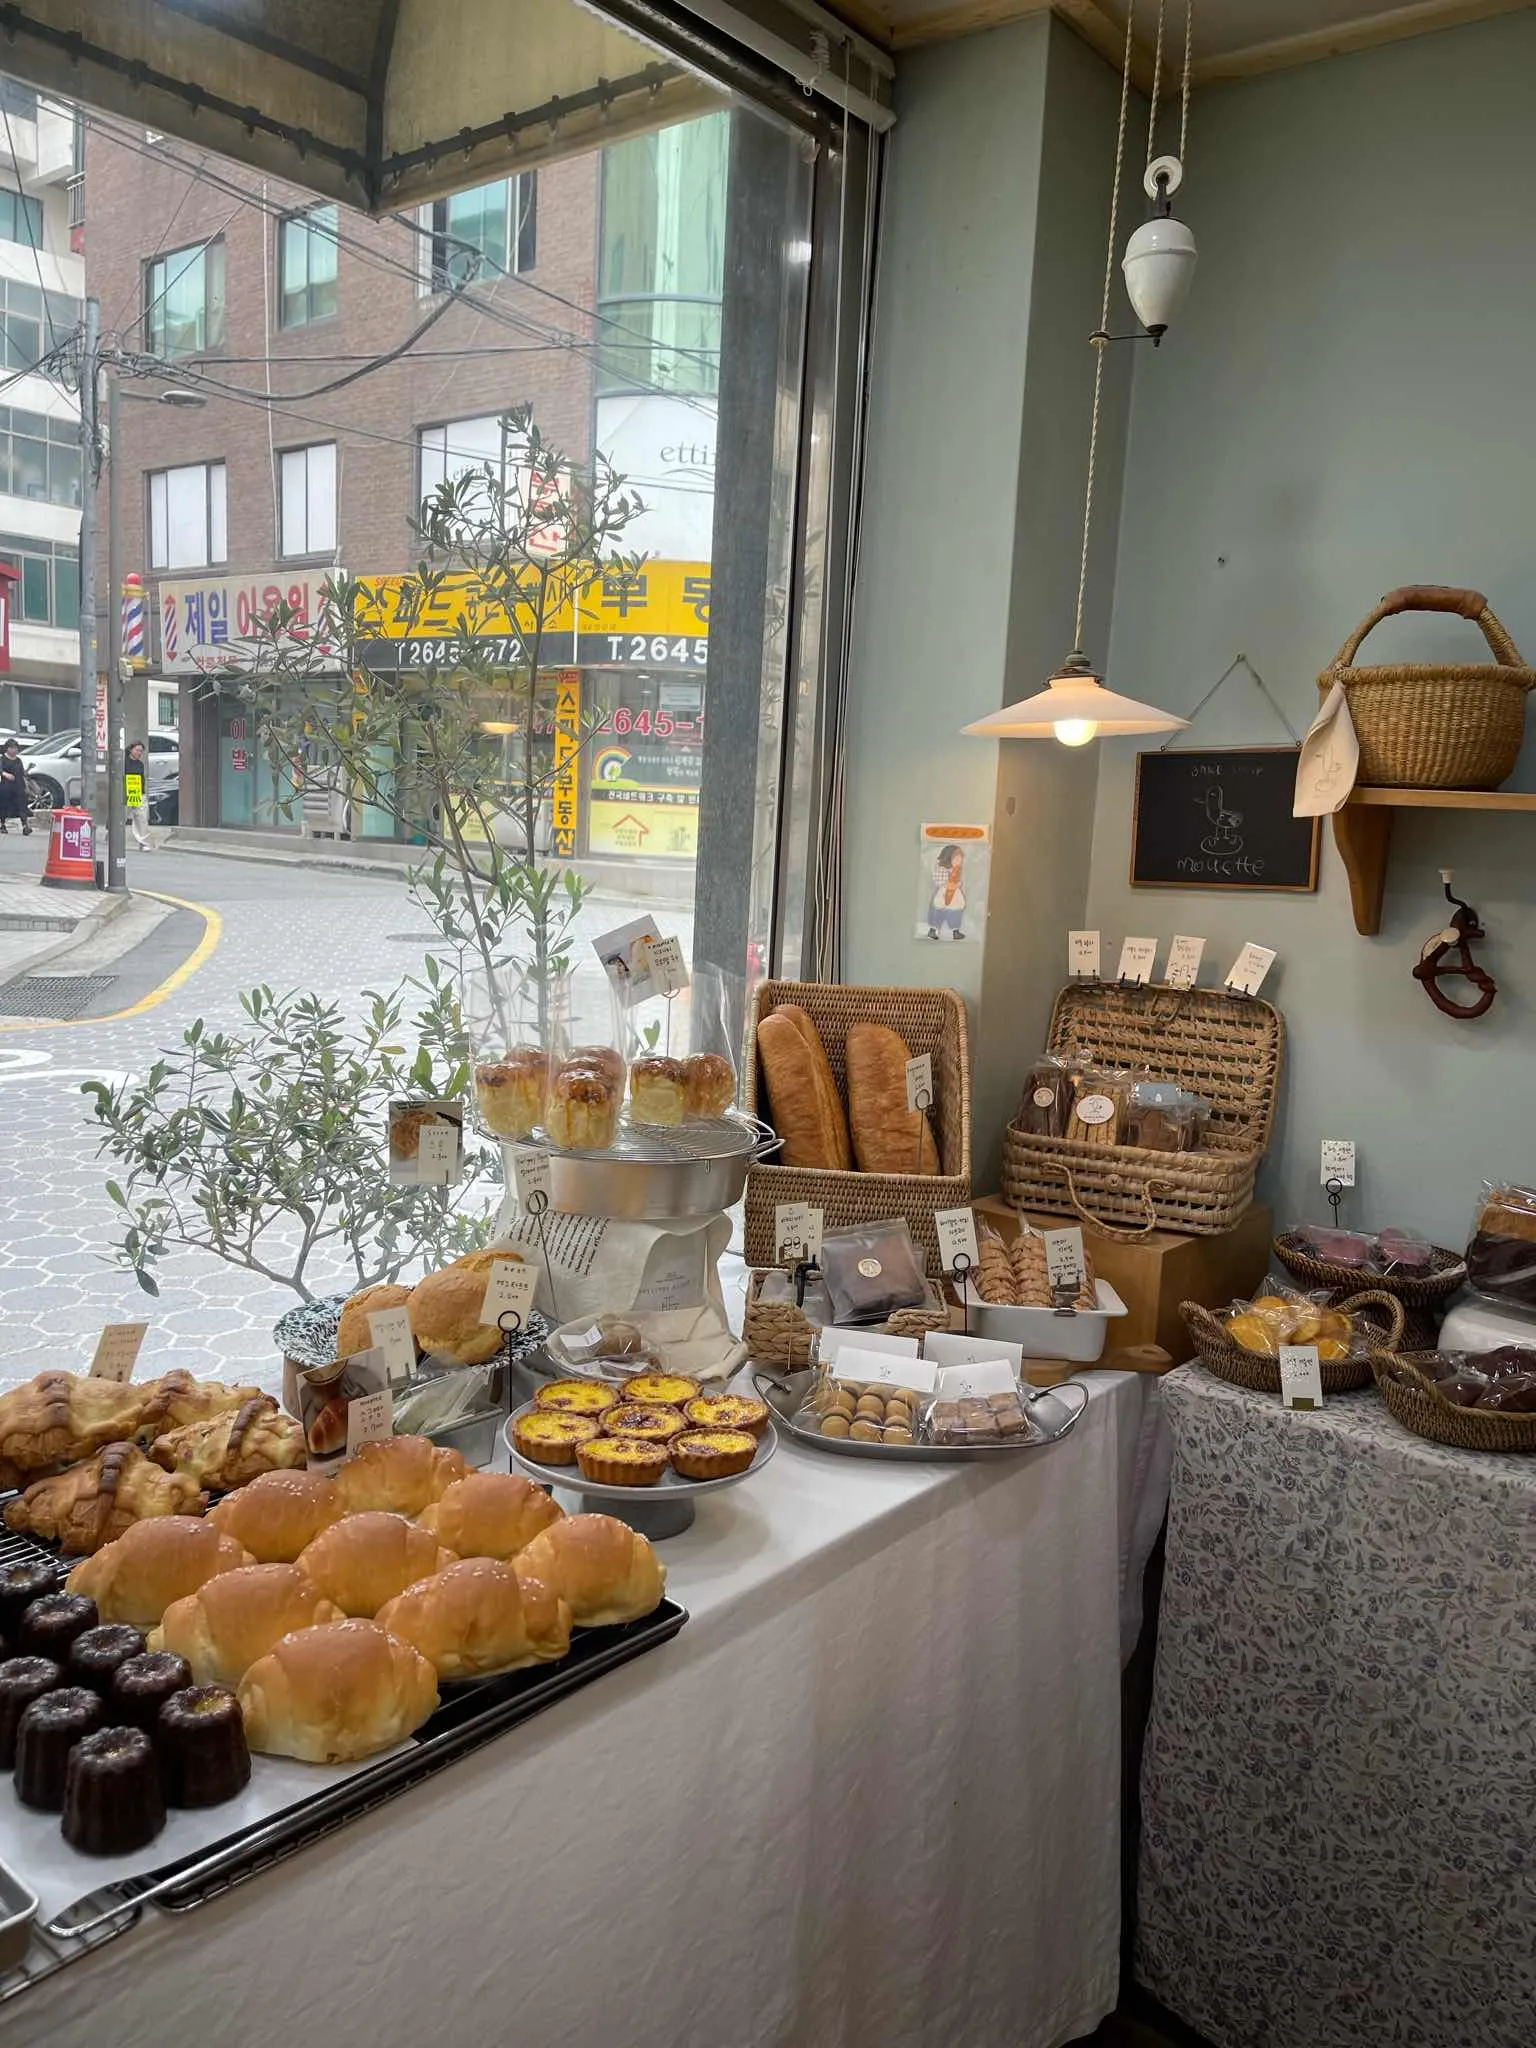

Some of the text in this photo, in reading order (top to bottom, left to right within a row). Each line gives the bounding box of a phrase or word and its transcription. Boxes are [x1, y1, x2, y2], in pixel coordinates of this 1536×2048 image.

[661, 442, 716, 465] etti
[184, 582, 309, 645] 제일 이용원
